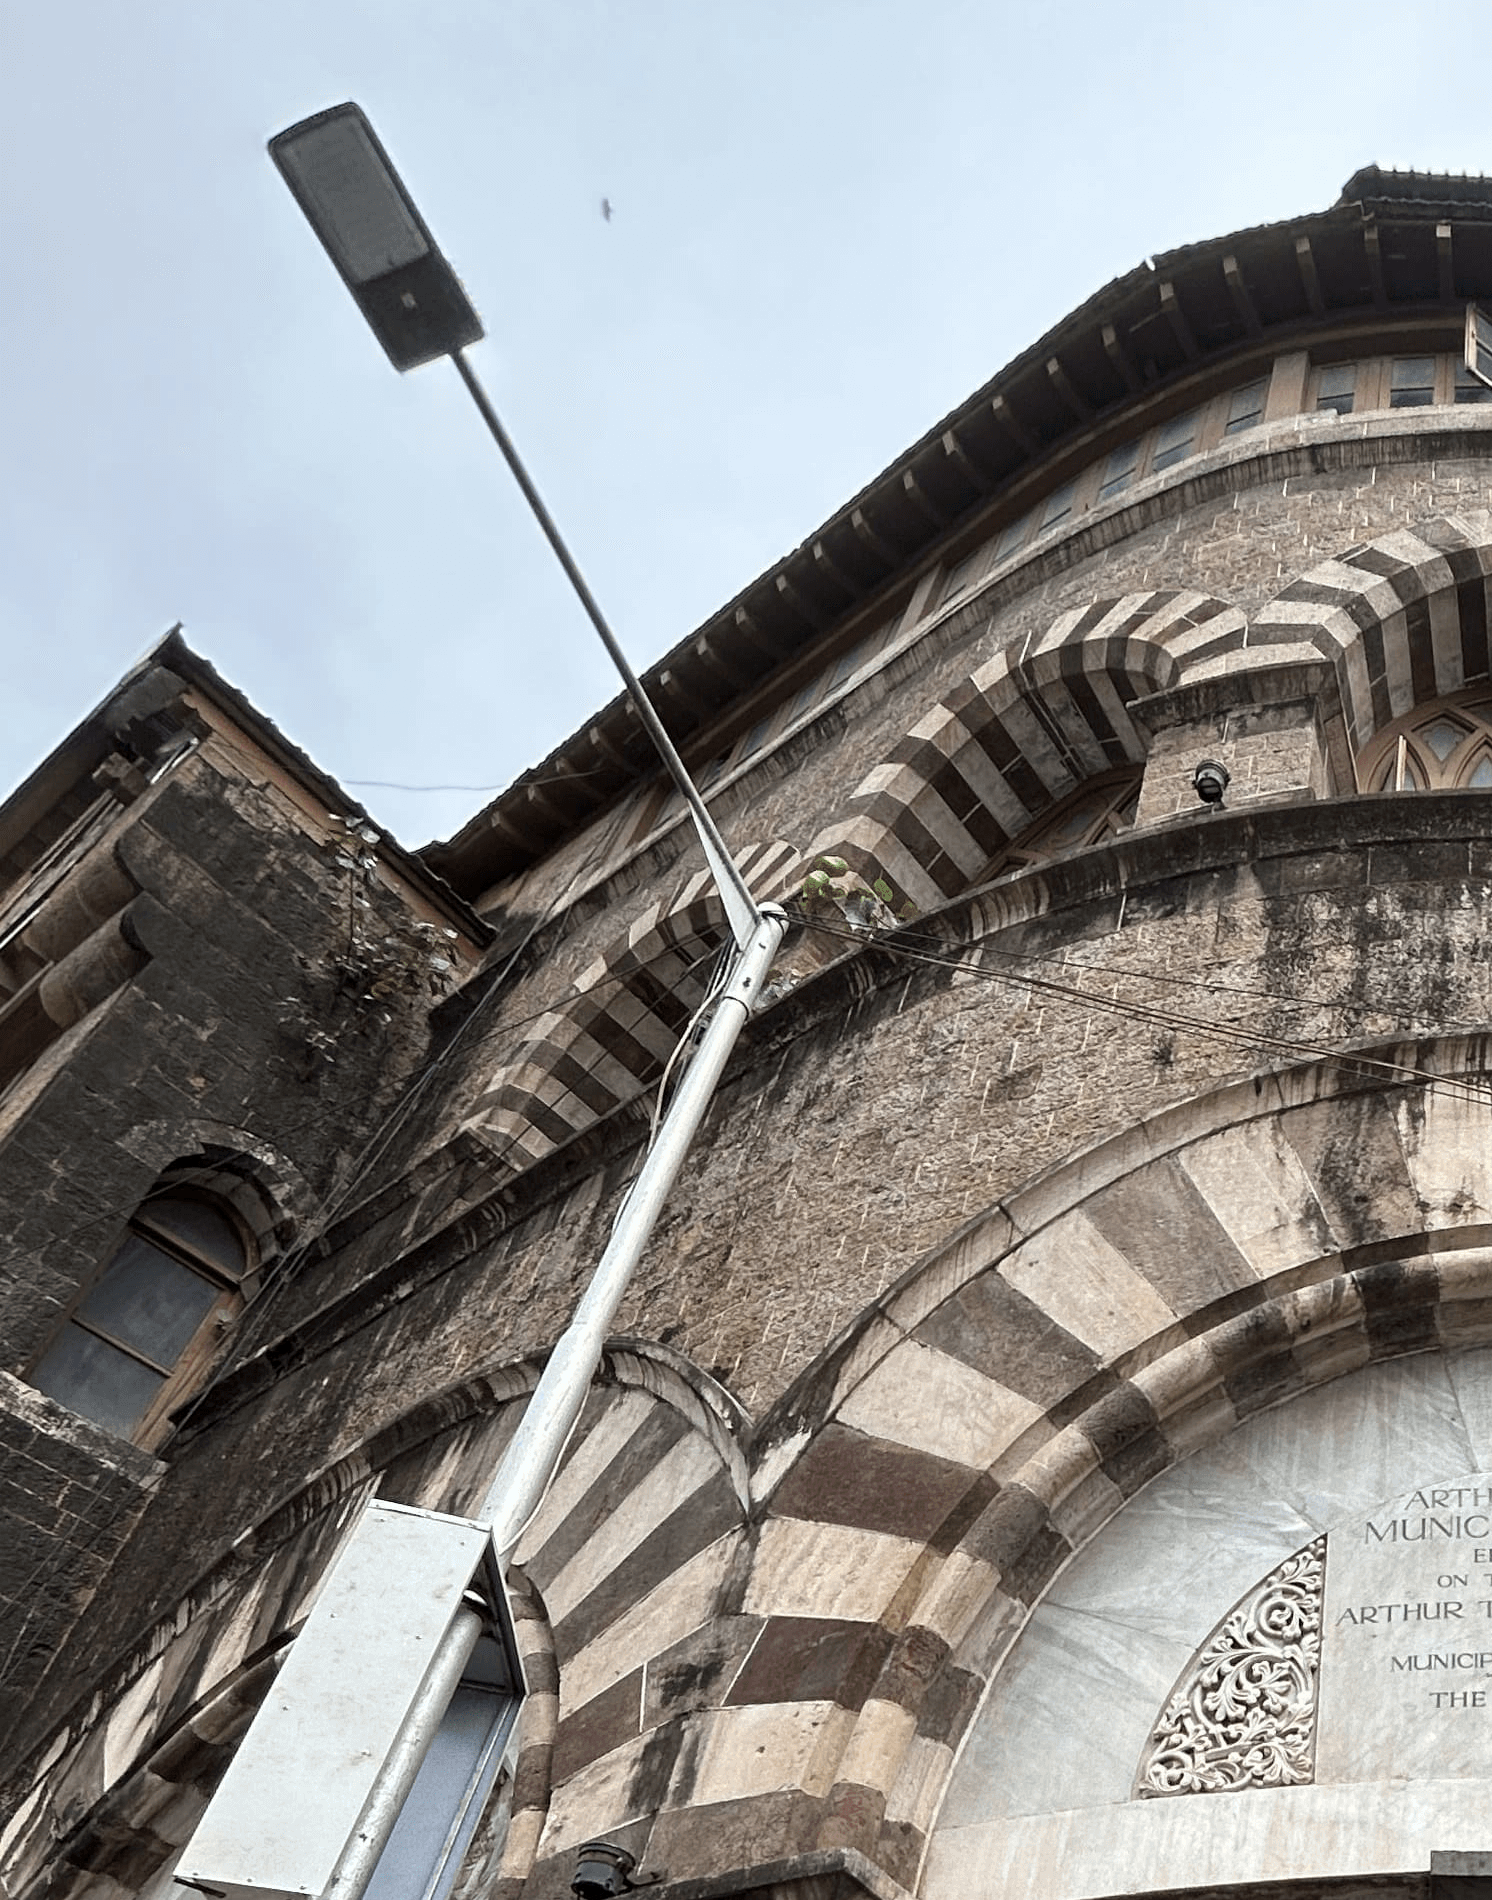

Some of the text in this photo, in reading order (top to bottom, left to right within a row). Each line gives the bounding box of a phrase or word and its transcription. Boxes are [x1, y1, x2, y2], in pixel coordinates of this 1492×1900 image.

[1437, 1573, 1469, 1588] ON
[1336, 1600, 1465, 1627] ARTHUR
[1428, 1690, 1487, 1709] THE
